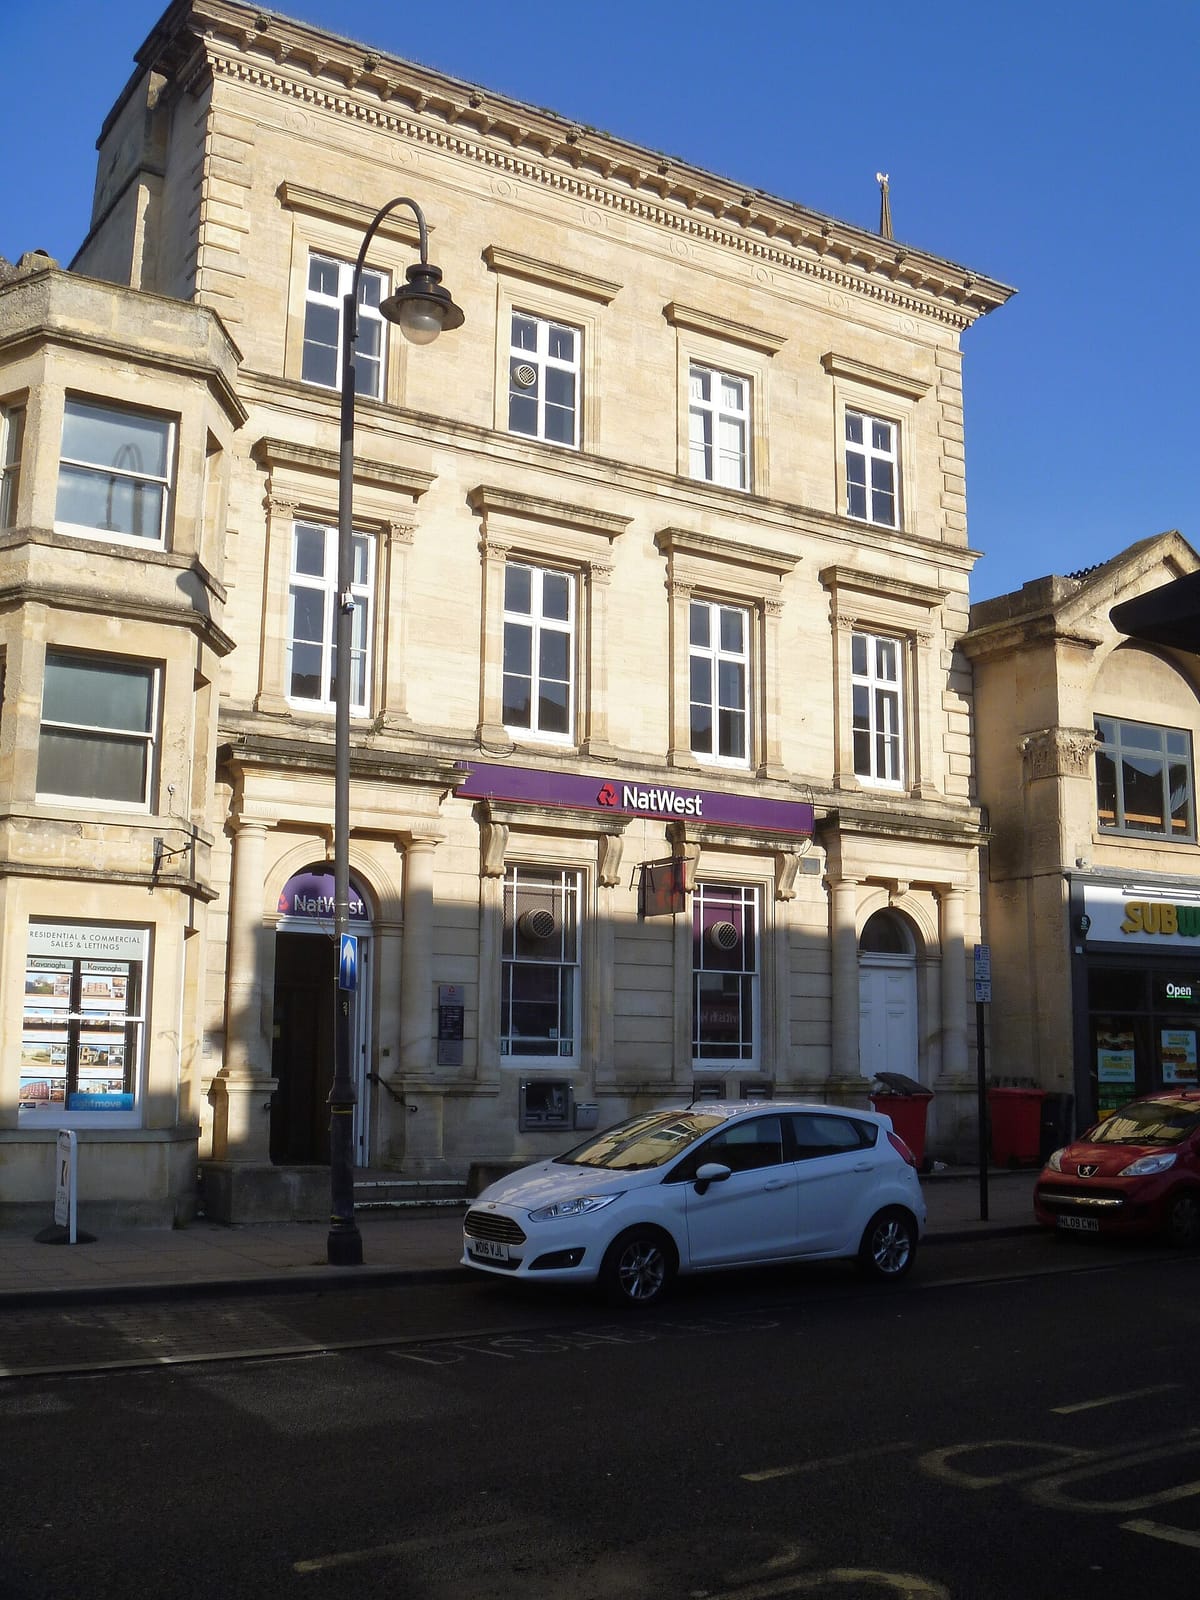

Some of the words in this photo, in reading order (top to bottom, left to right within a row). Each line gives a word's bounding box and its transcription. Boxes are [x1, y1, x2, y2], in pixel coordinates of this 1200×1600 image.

[623, 785, 702, 815] NatWest
[293, 894, 364, 915] NatWst
[29, 931, 78, 940] RESIDENTIAL
[89, 934, 140, 943] COMMERCIAL
[50, 940, 74, 948] SALES
[84, 942, 120, 950] LETTINGS
[30, 960, 66, 969] Kavanaghs
[87, 963, 122, 972] Kavanaghs
[1166, 983, 1192, 998] Open
